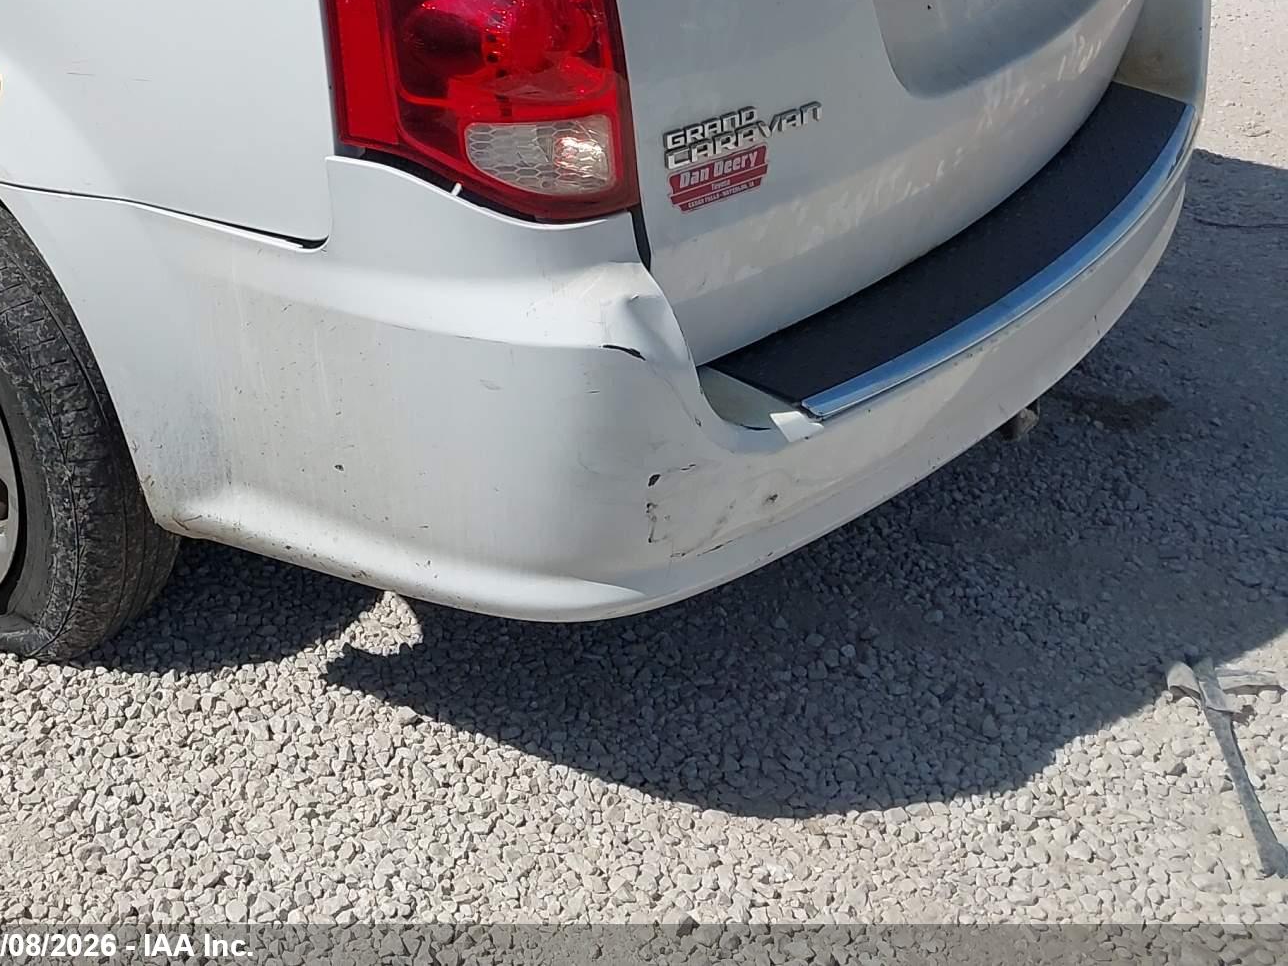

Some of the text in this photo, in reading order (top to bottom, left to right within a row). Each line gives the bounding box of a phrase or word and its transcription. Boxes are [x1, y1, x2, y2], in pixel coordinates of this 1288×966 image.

[663, 106, 759, 150] GRAND
[665, 101, 823, 170] CARAVAN
[679, 151, 758, 189] Dan Deery
